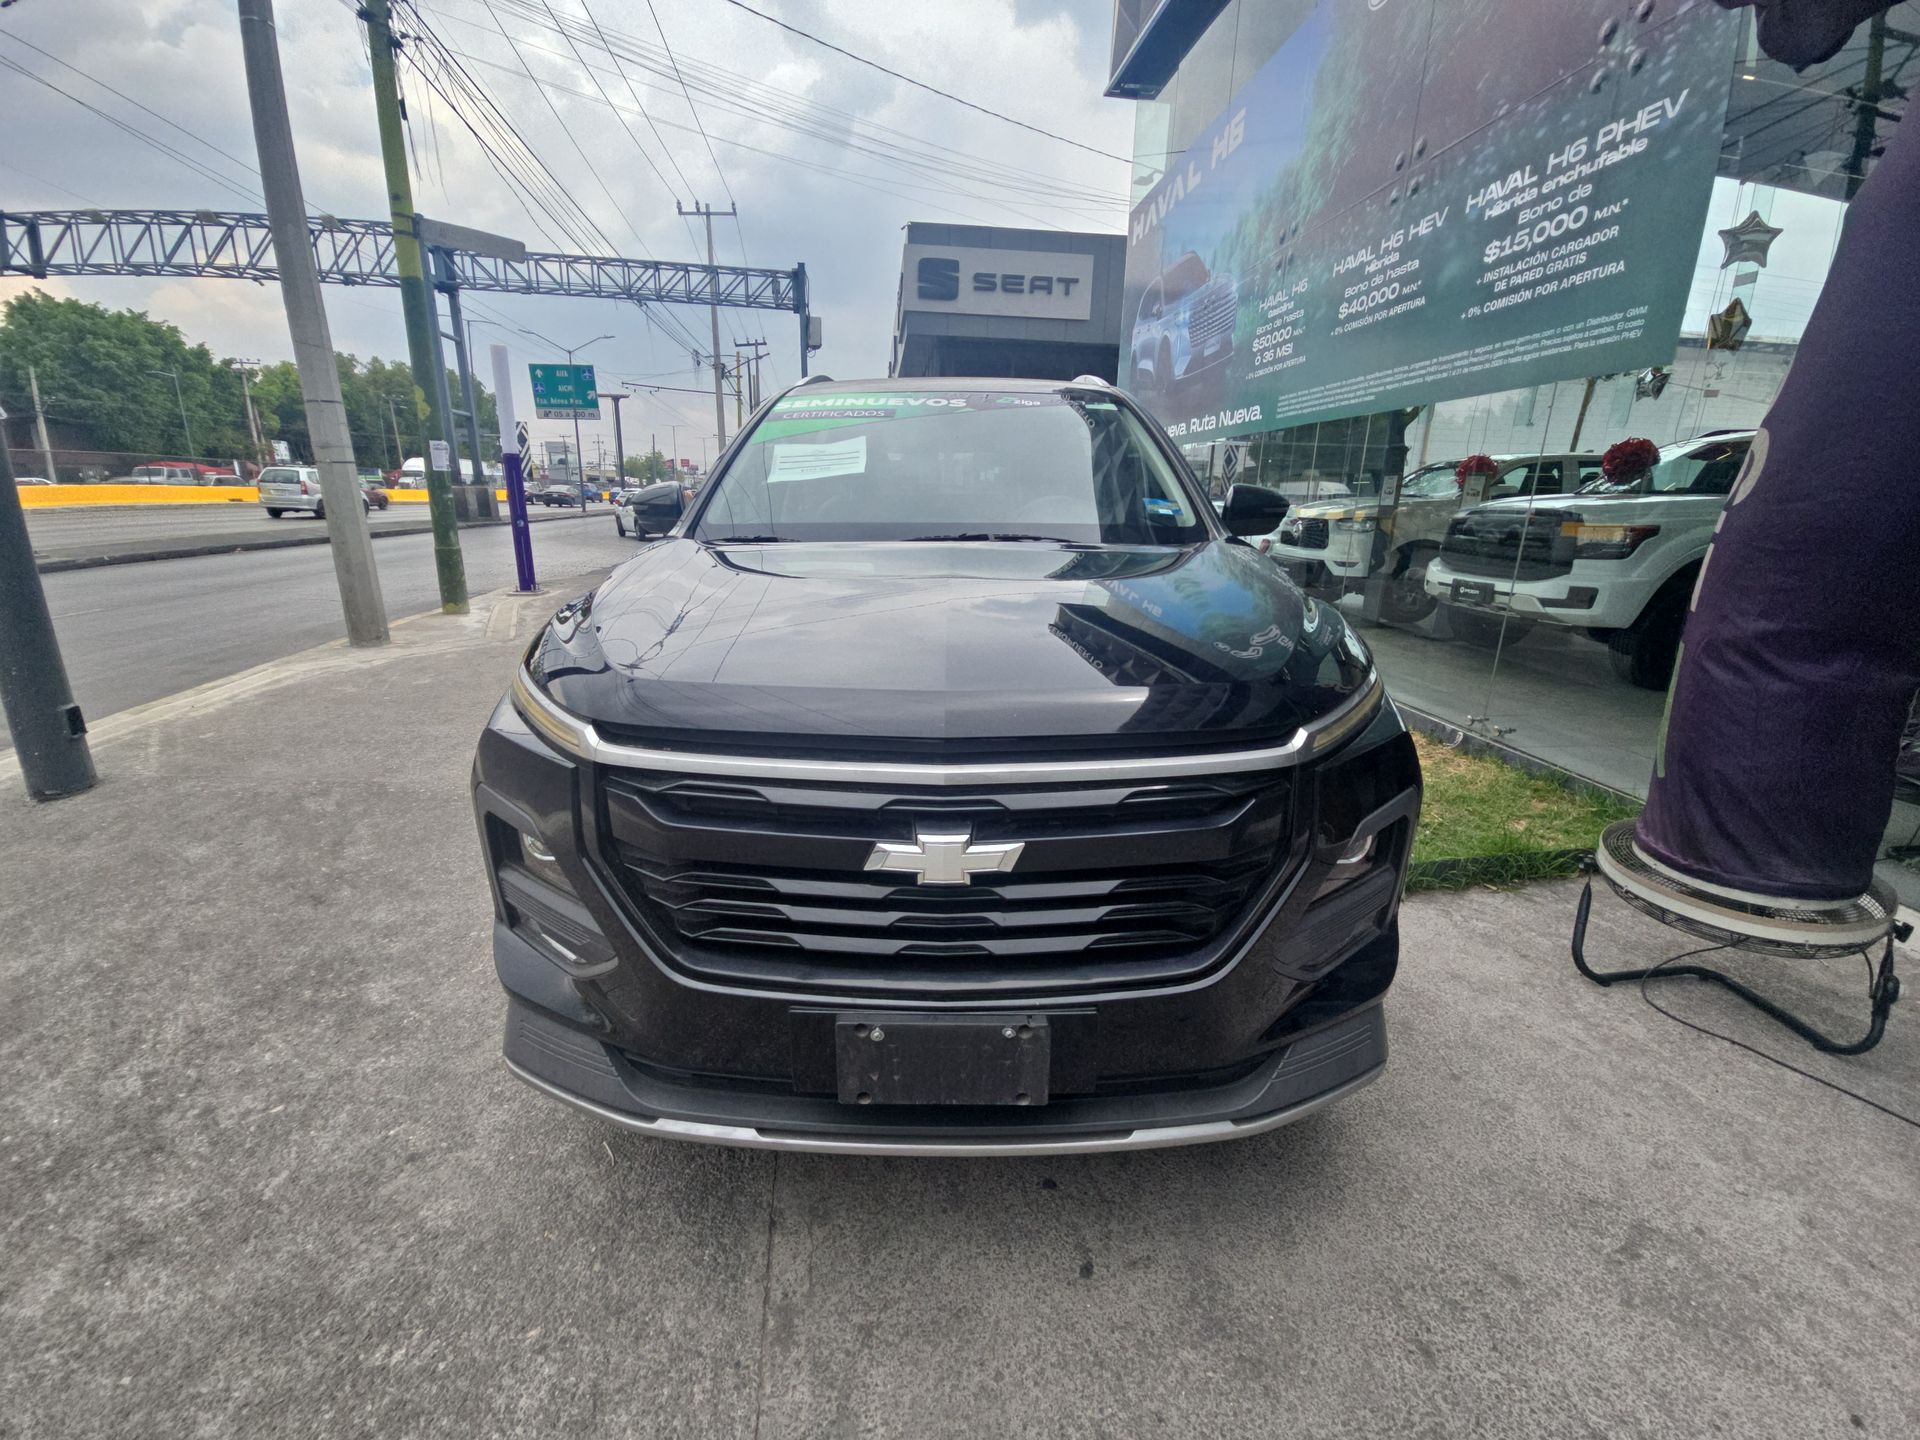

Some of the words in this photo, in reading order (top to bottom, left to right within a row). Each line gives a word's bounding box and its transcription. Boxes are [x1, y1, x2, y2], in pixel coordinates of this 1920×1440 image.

[1465, 165, 1538, 214] HAVAL
[1546, 137, 1588, 174] H6
[1596, 88, 1689, 151] PHEV
[1542, 137, 1648, 194] enchufable
[1132, 160, 1202, 247] HAVAL
[1211, 107, 1247, 171] H6
[1518, 197, 1562, 225] Bono
[1568, 184, 1592, 203] de
[1333, 245, 1376, 278] HAVAL
[1380, 229, 1404, 254] H6
[1408, 206, 1449, 242] HEV
[1483, 250, 1549, 284] INSTALACIÓN
[1551, 225, 1620, 259] CARGADOR
[1484, 205, 1588, 264] $15,000
[973, 272, 1080, 296] SEAT
[1344, 281, 1369, 298] Bono
[1371, 273, 1384, 287] de
[1386, 259, 1420, 281] hasta
[1467, 304, 1481, 318] 0%
[1483, 287, 1533, 313] COMISIÓN
[1534, 281, 1558, 297] POR
[1559, 260, 1626, 290] APERTURA
[1494, 279, 1510, 292] DE
[1509, 269, 1543, 287] PARED
[1546, 251, 1588, 274] GRATIS
[1259, 288, 1289, 312] HAVAL
[1292, 278, 1308, 297] H6
[1338, 282, 1400, 320] $40,000
[1252, 326, 1292, 352] $50,000
[775, 397, 967, 410] SEMINUEVOS
[783, 410, 885, 419] CERTIFICADOS
[1164, 422, 1187, 438] ueva.
[1190, 414, 1216, 433] Ruta
[1218, 405, 1263, 428] Nueva.
